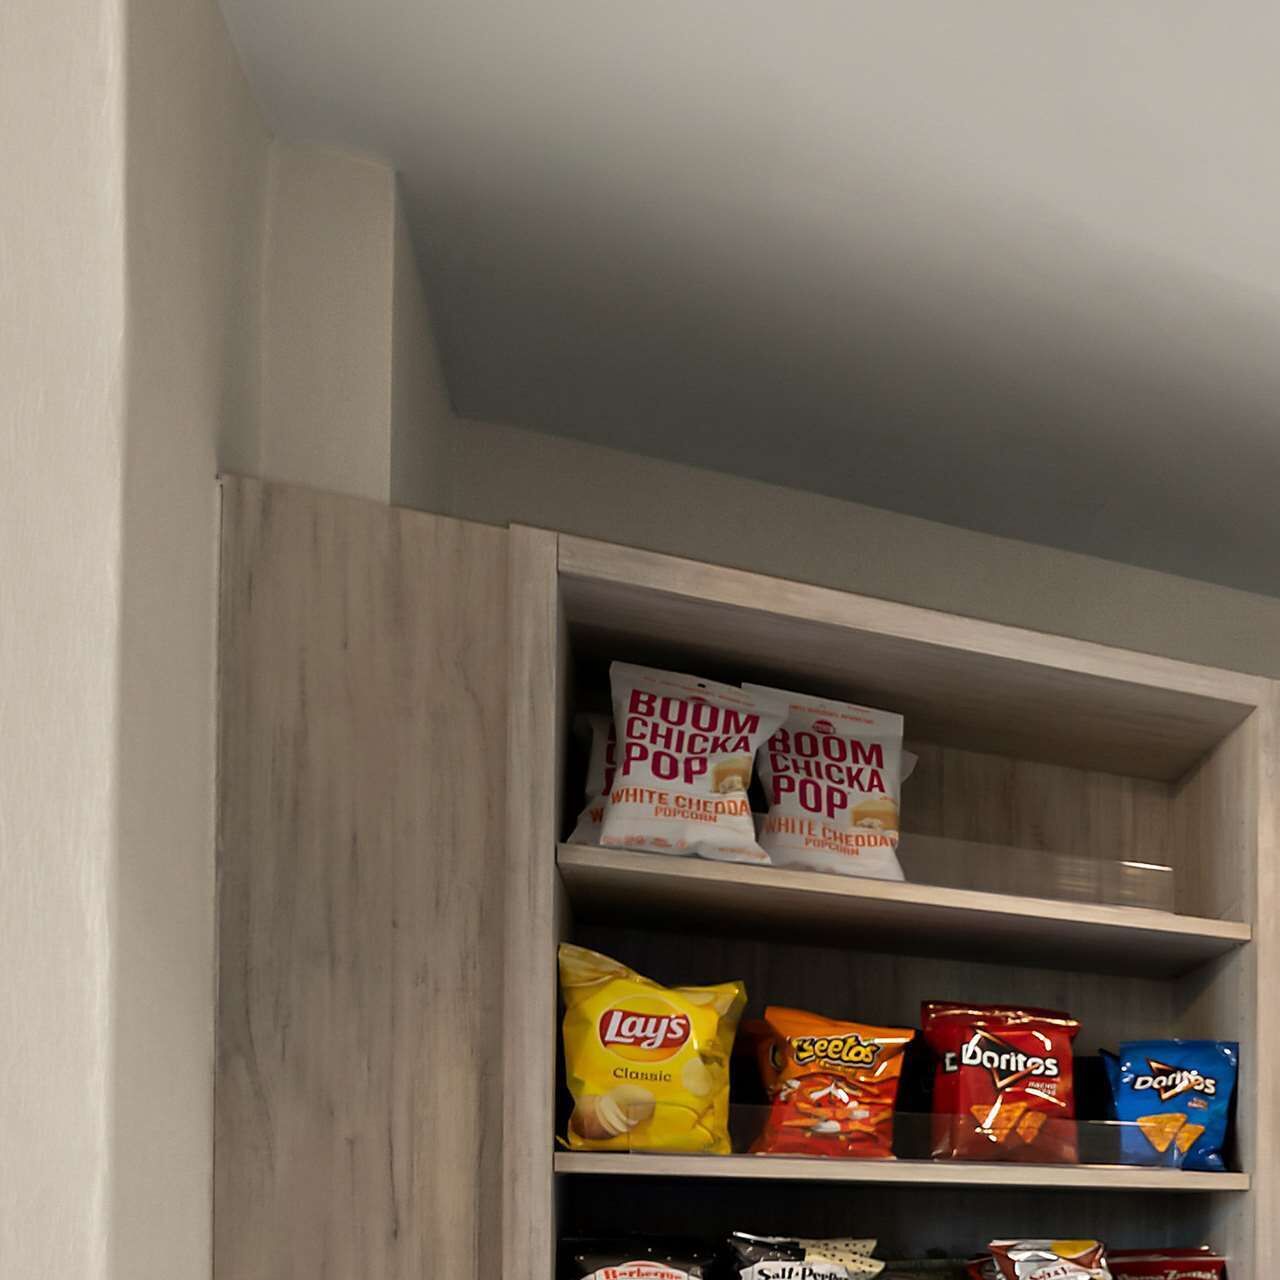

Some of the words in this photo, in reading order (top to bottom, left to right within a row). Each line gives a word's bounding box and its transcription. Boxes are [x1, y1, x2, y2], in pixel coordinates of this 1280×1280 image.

[628, 688, 760, 735] BOOM
[626, 716, 750, 755] CHICKA
[768, 728, 884, 769] BOOM
[622, 742, 708, 785] POP
[769, 752, 886, 793] CHICKA
[611, 787, 669, 805] WHITE
[674, 795, 751, 816] CHEDDA
[654, 806, 717, 823] POPCORN
[772, 774, 849, 819] POP
[604, 1010, 687, 1049] Lay's
[613, 1067, 672, 1083] Classic
[961, 1043, 1059, 1077] Doritos
[1133, 1071, 1216, 1095] Doritos
